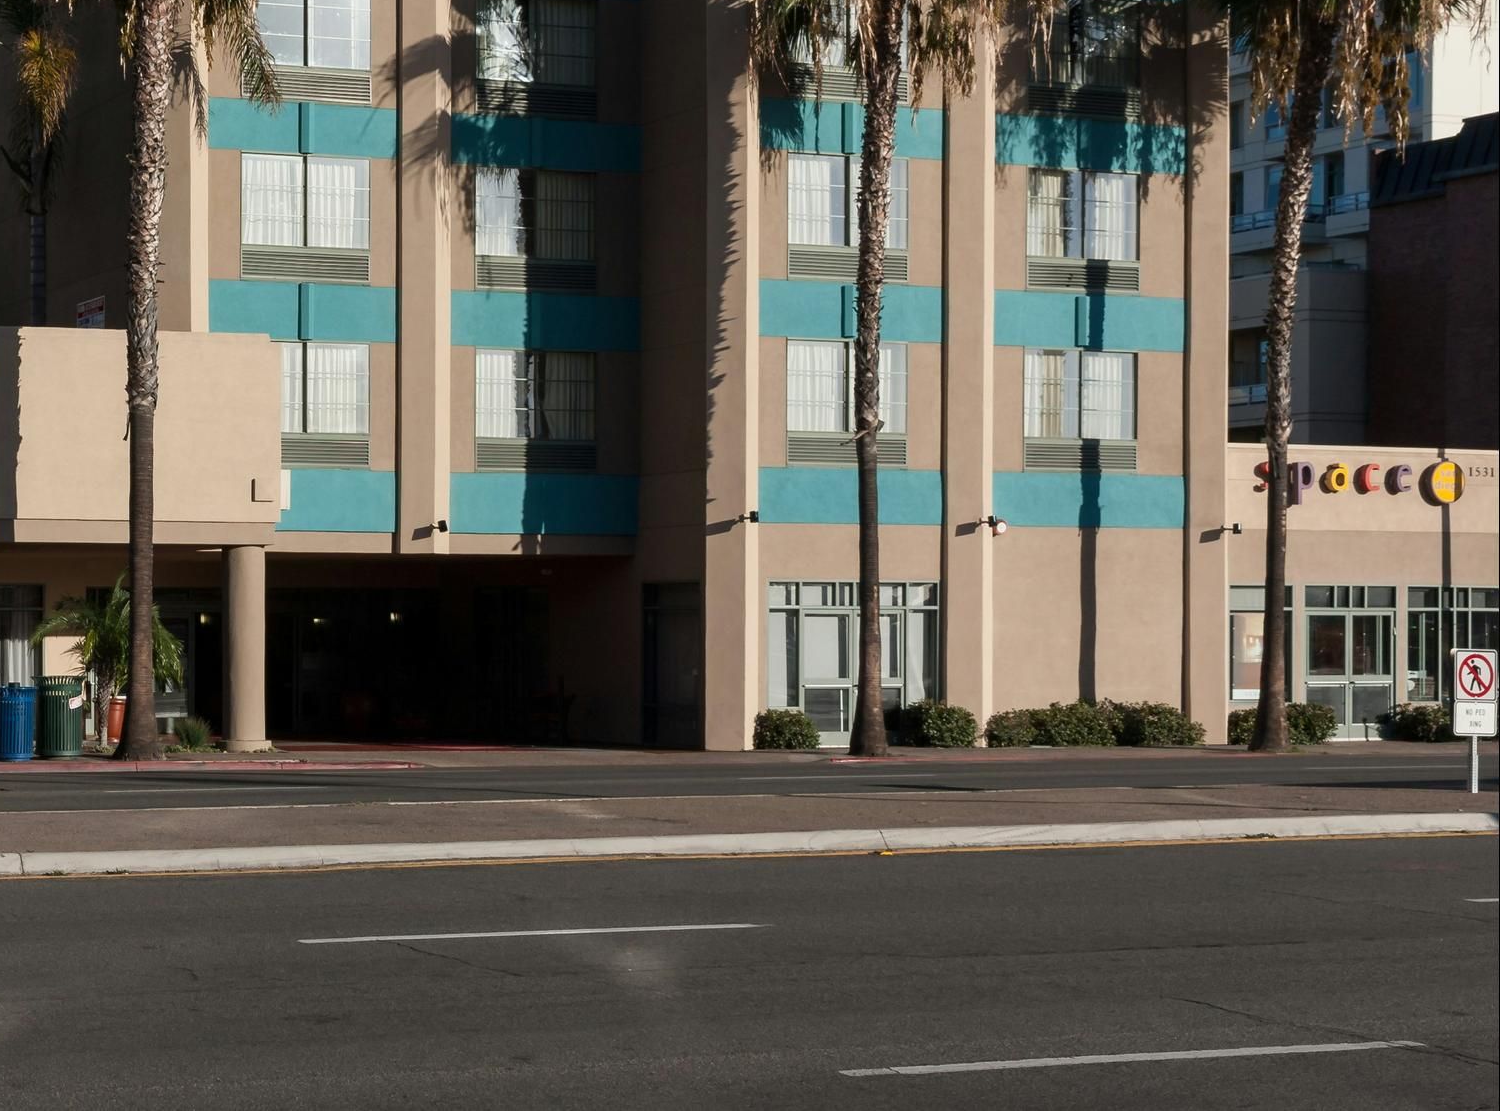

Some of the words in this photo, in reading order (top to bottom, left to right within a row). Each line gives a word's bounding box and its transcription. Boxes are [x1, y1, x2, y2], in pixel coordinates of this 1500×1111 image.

[1468, 466, 1495, 477] 1531
[1465, 708, 1473, 716] NO
[1475, 708, 1486, 716] PED
